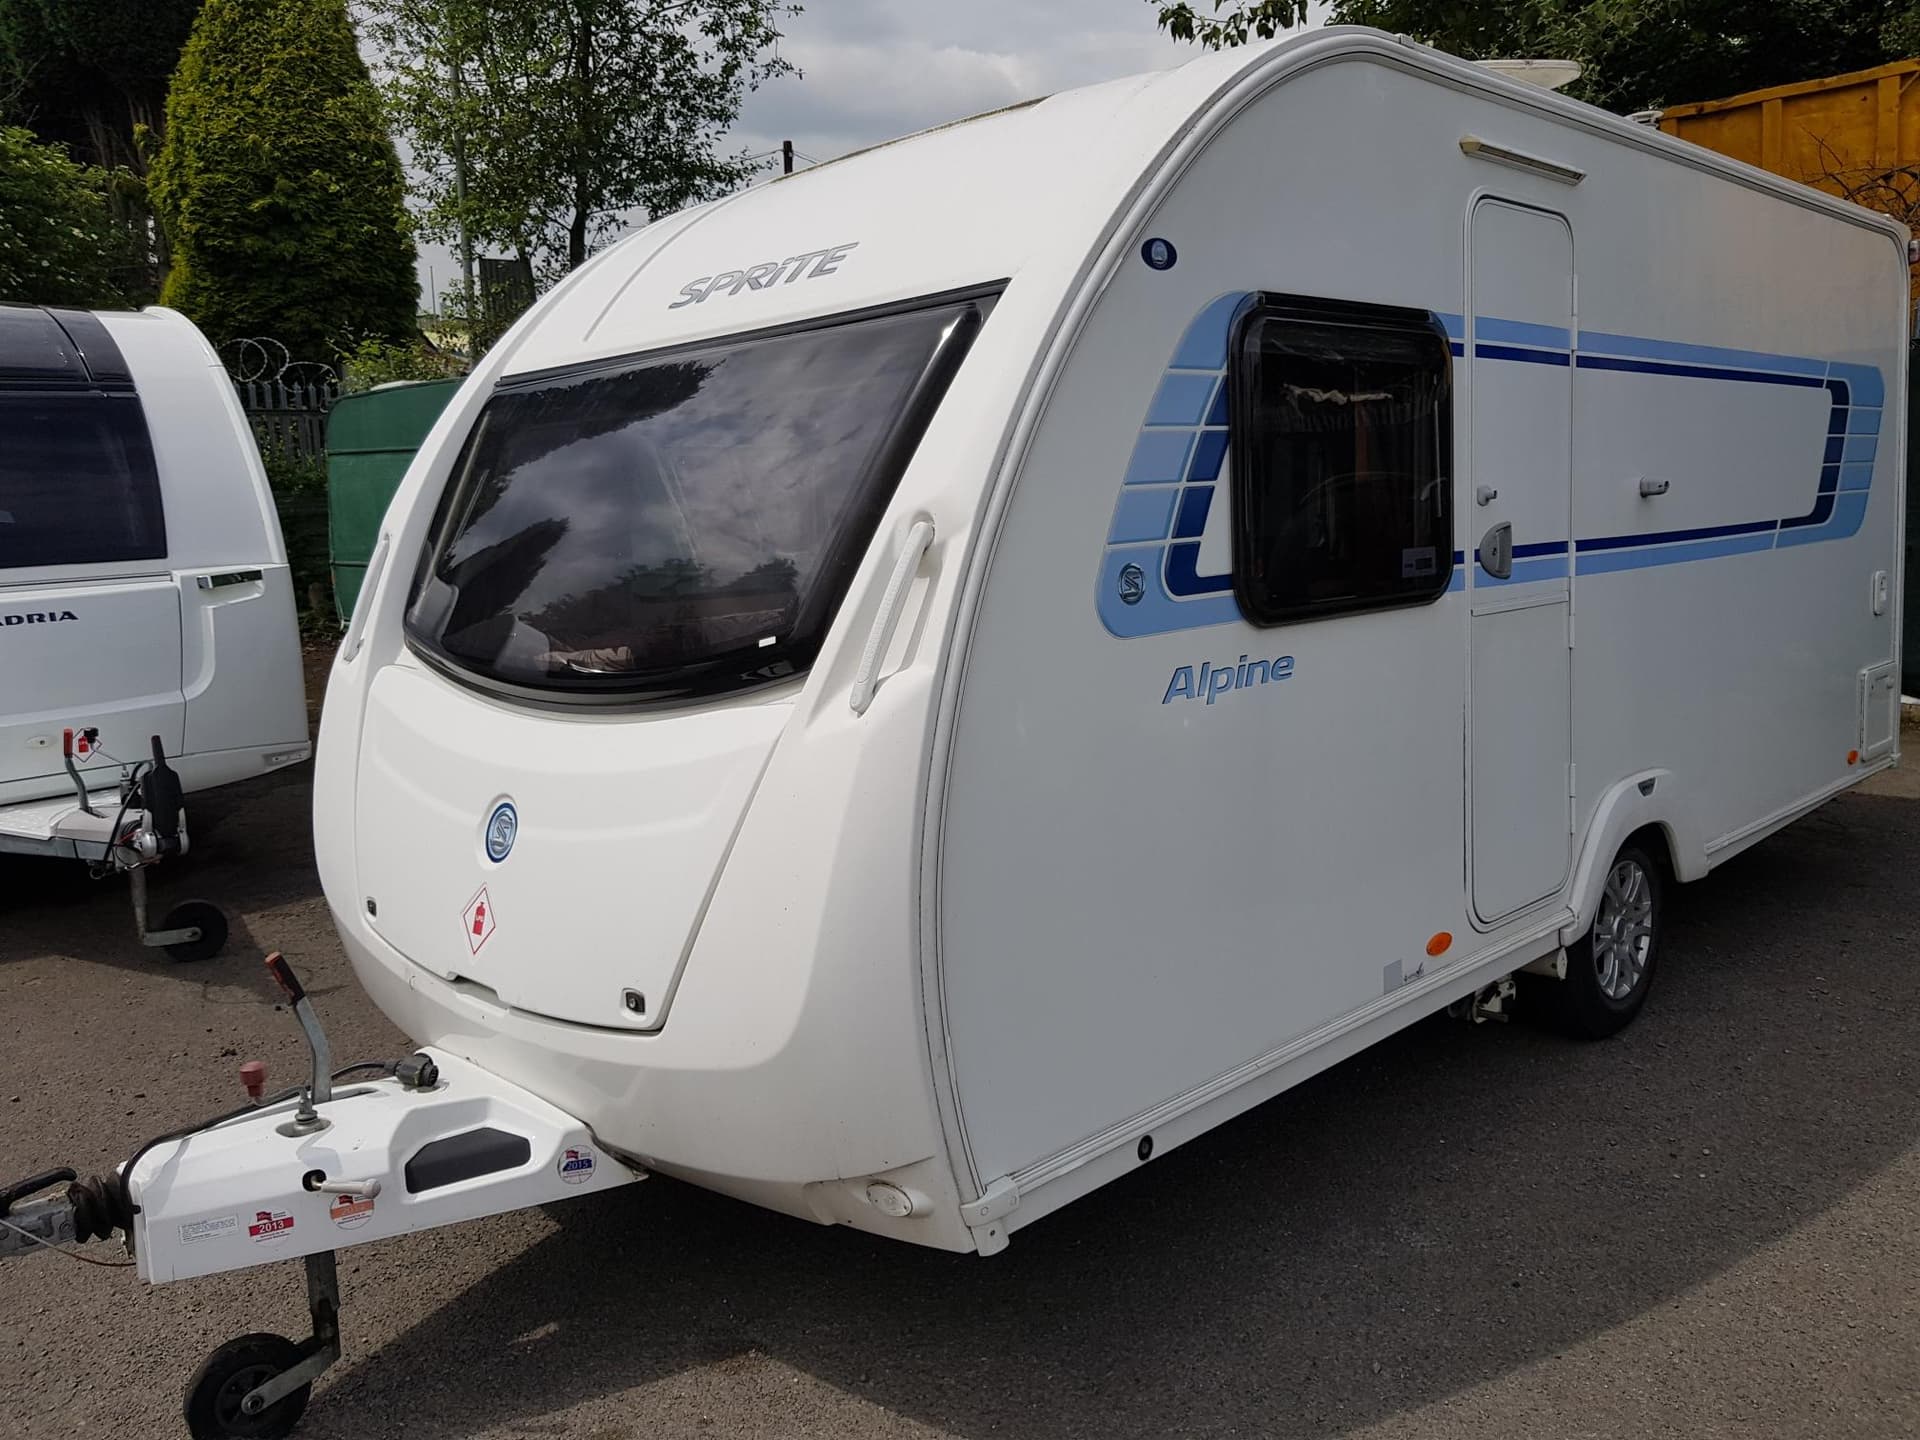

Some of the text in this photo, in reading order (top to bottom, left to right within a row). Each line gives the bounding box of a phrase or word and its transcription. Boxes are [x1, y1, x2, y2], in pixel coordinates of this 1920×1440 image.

[0, 611, 79, 627] DRIA
[1161, 654, 1296, 706] Alpine
[566, 1160, 589, 1171] 2015
[258, 1220, 285, 1233] 2013
